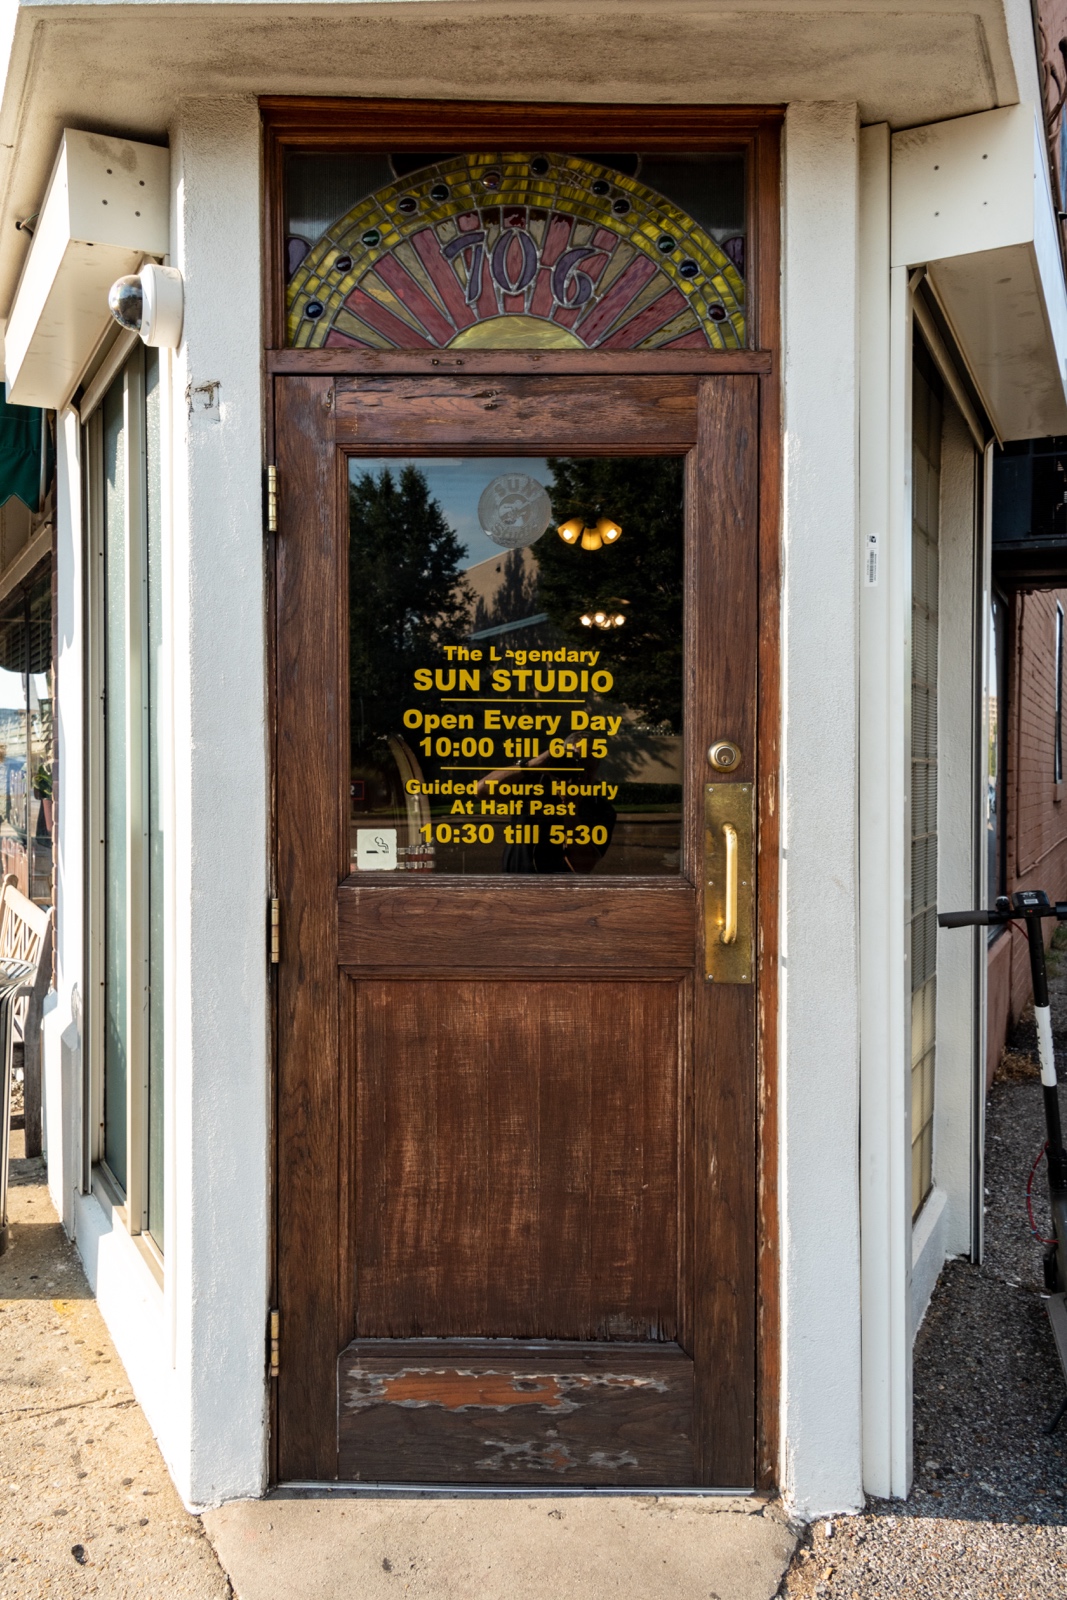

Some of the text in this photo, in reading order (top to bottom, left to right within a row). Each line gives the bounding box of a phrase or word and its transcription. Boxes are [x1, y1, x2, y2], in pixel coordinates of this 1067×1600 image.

[442, 228, 596, 308] 706
[444, 646, 482, 661] The
[413, 669, 614, 692] SUN STUDIO
[403, 709, 622, 736] Open Every Day
[419, 737, 608, 758] 10:00 till 6:15
[405, 779, 618, 799] Guided Tours Hourly
[450, 800, 576, 816] At Half Past
[419, 823, 608, 845] 10:30 till 5:30
